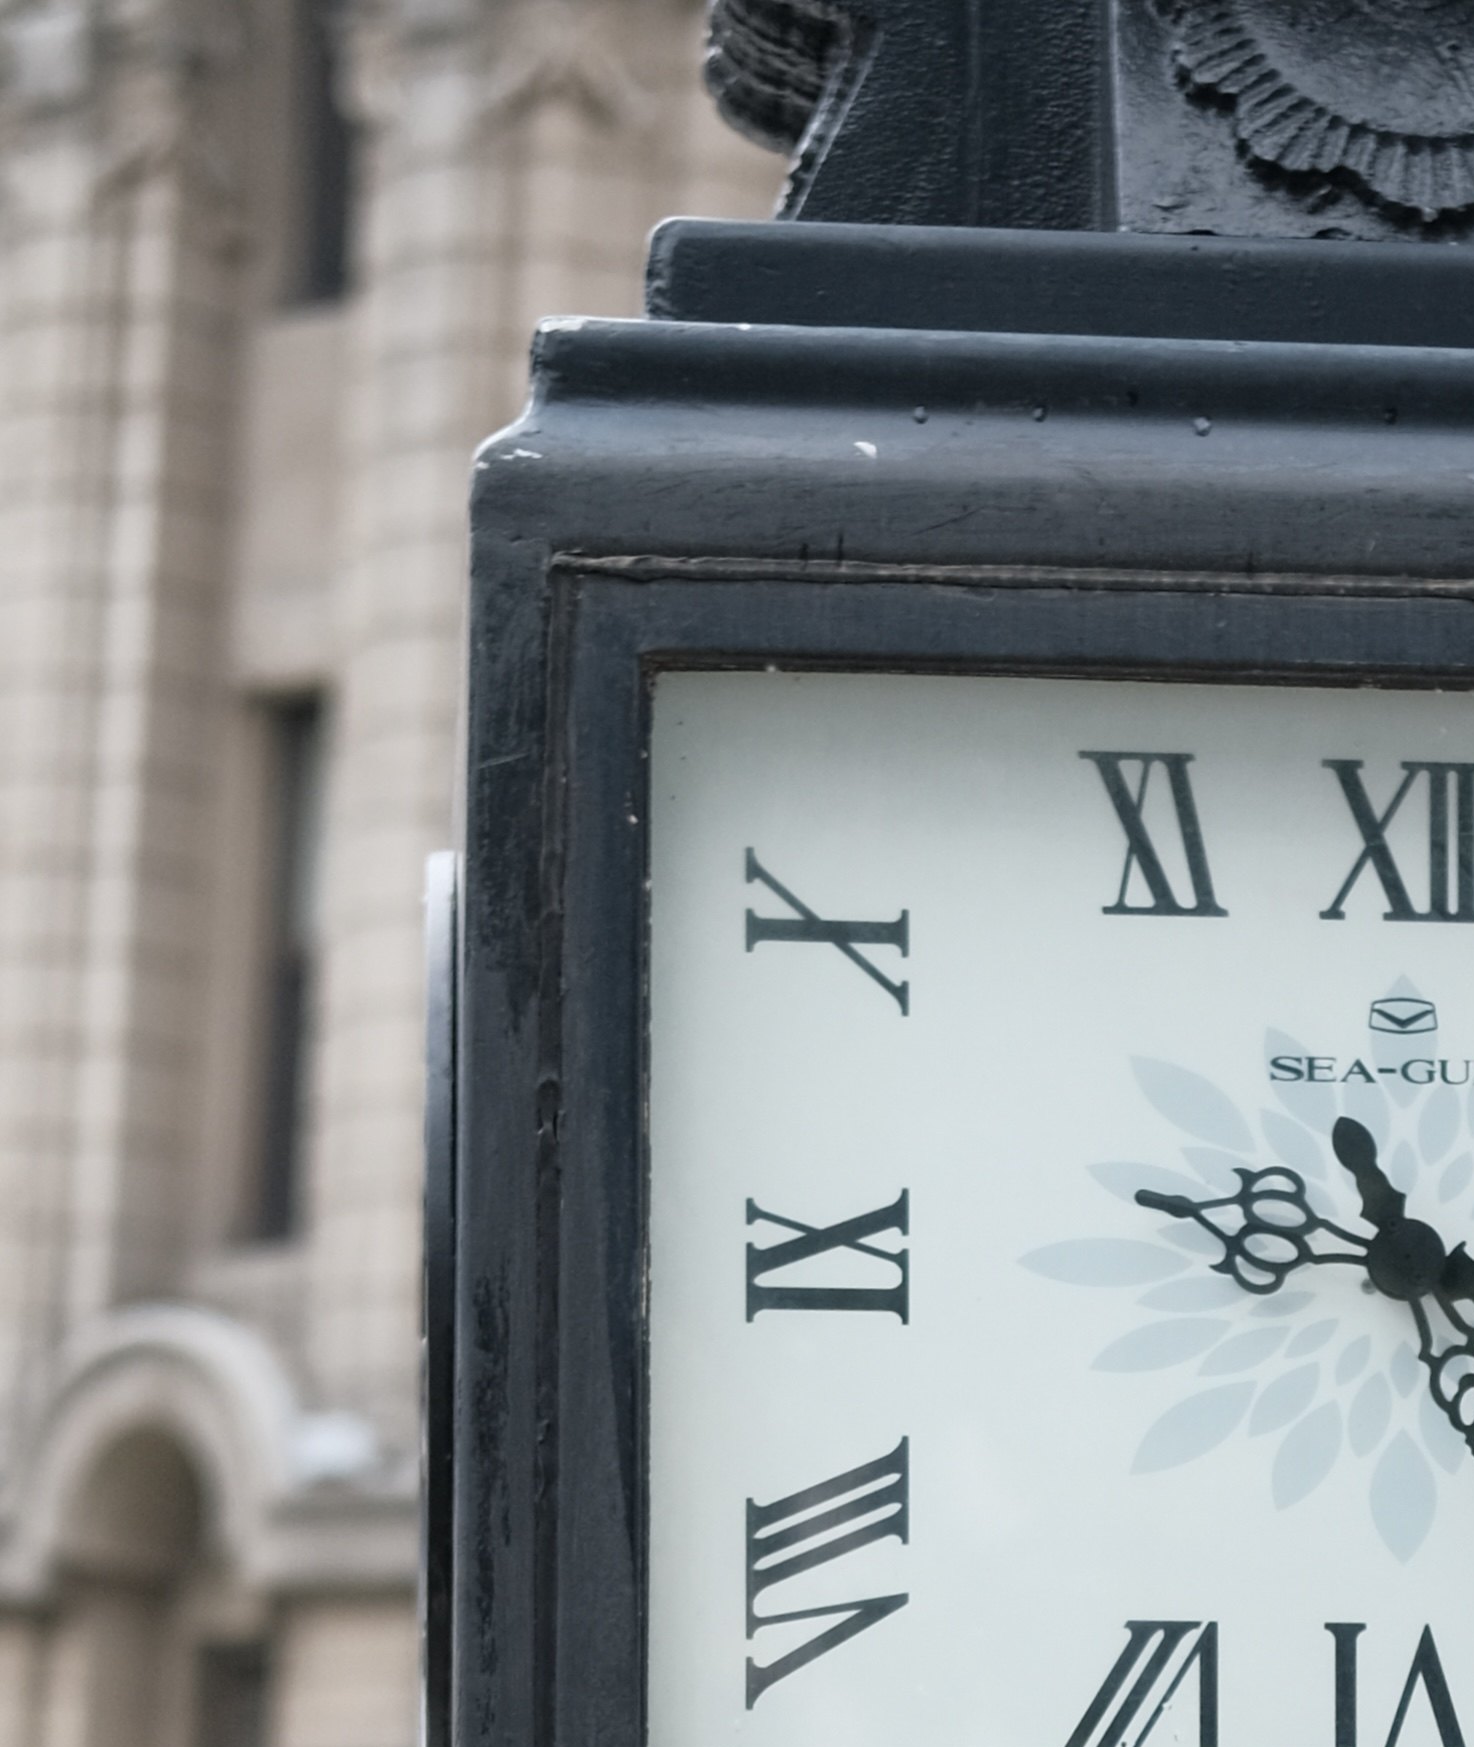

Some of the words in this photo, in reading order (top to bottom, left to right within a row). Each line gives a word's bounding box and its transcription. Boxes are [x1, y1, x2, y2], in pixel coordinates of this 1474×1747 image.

[1077, 749, 1229, 918] XI
[746, 847, 909, 1016] X
[746, 1188, 909, 1325] IX
[746, 1435, 909, 1711] VIII
